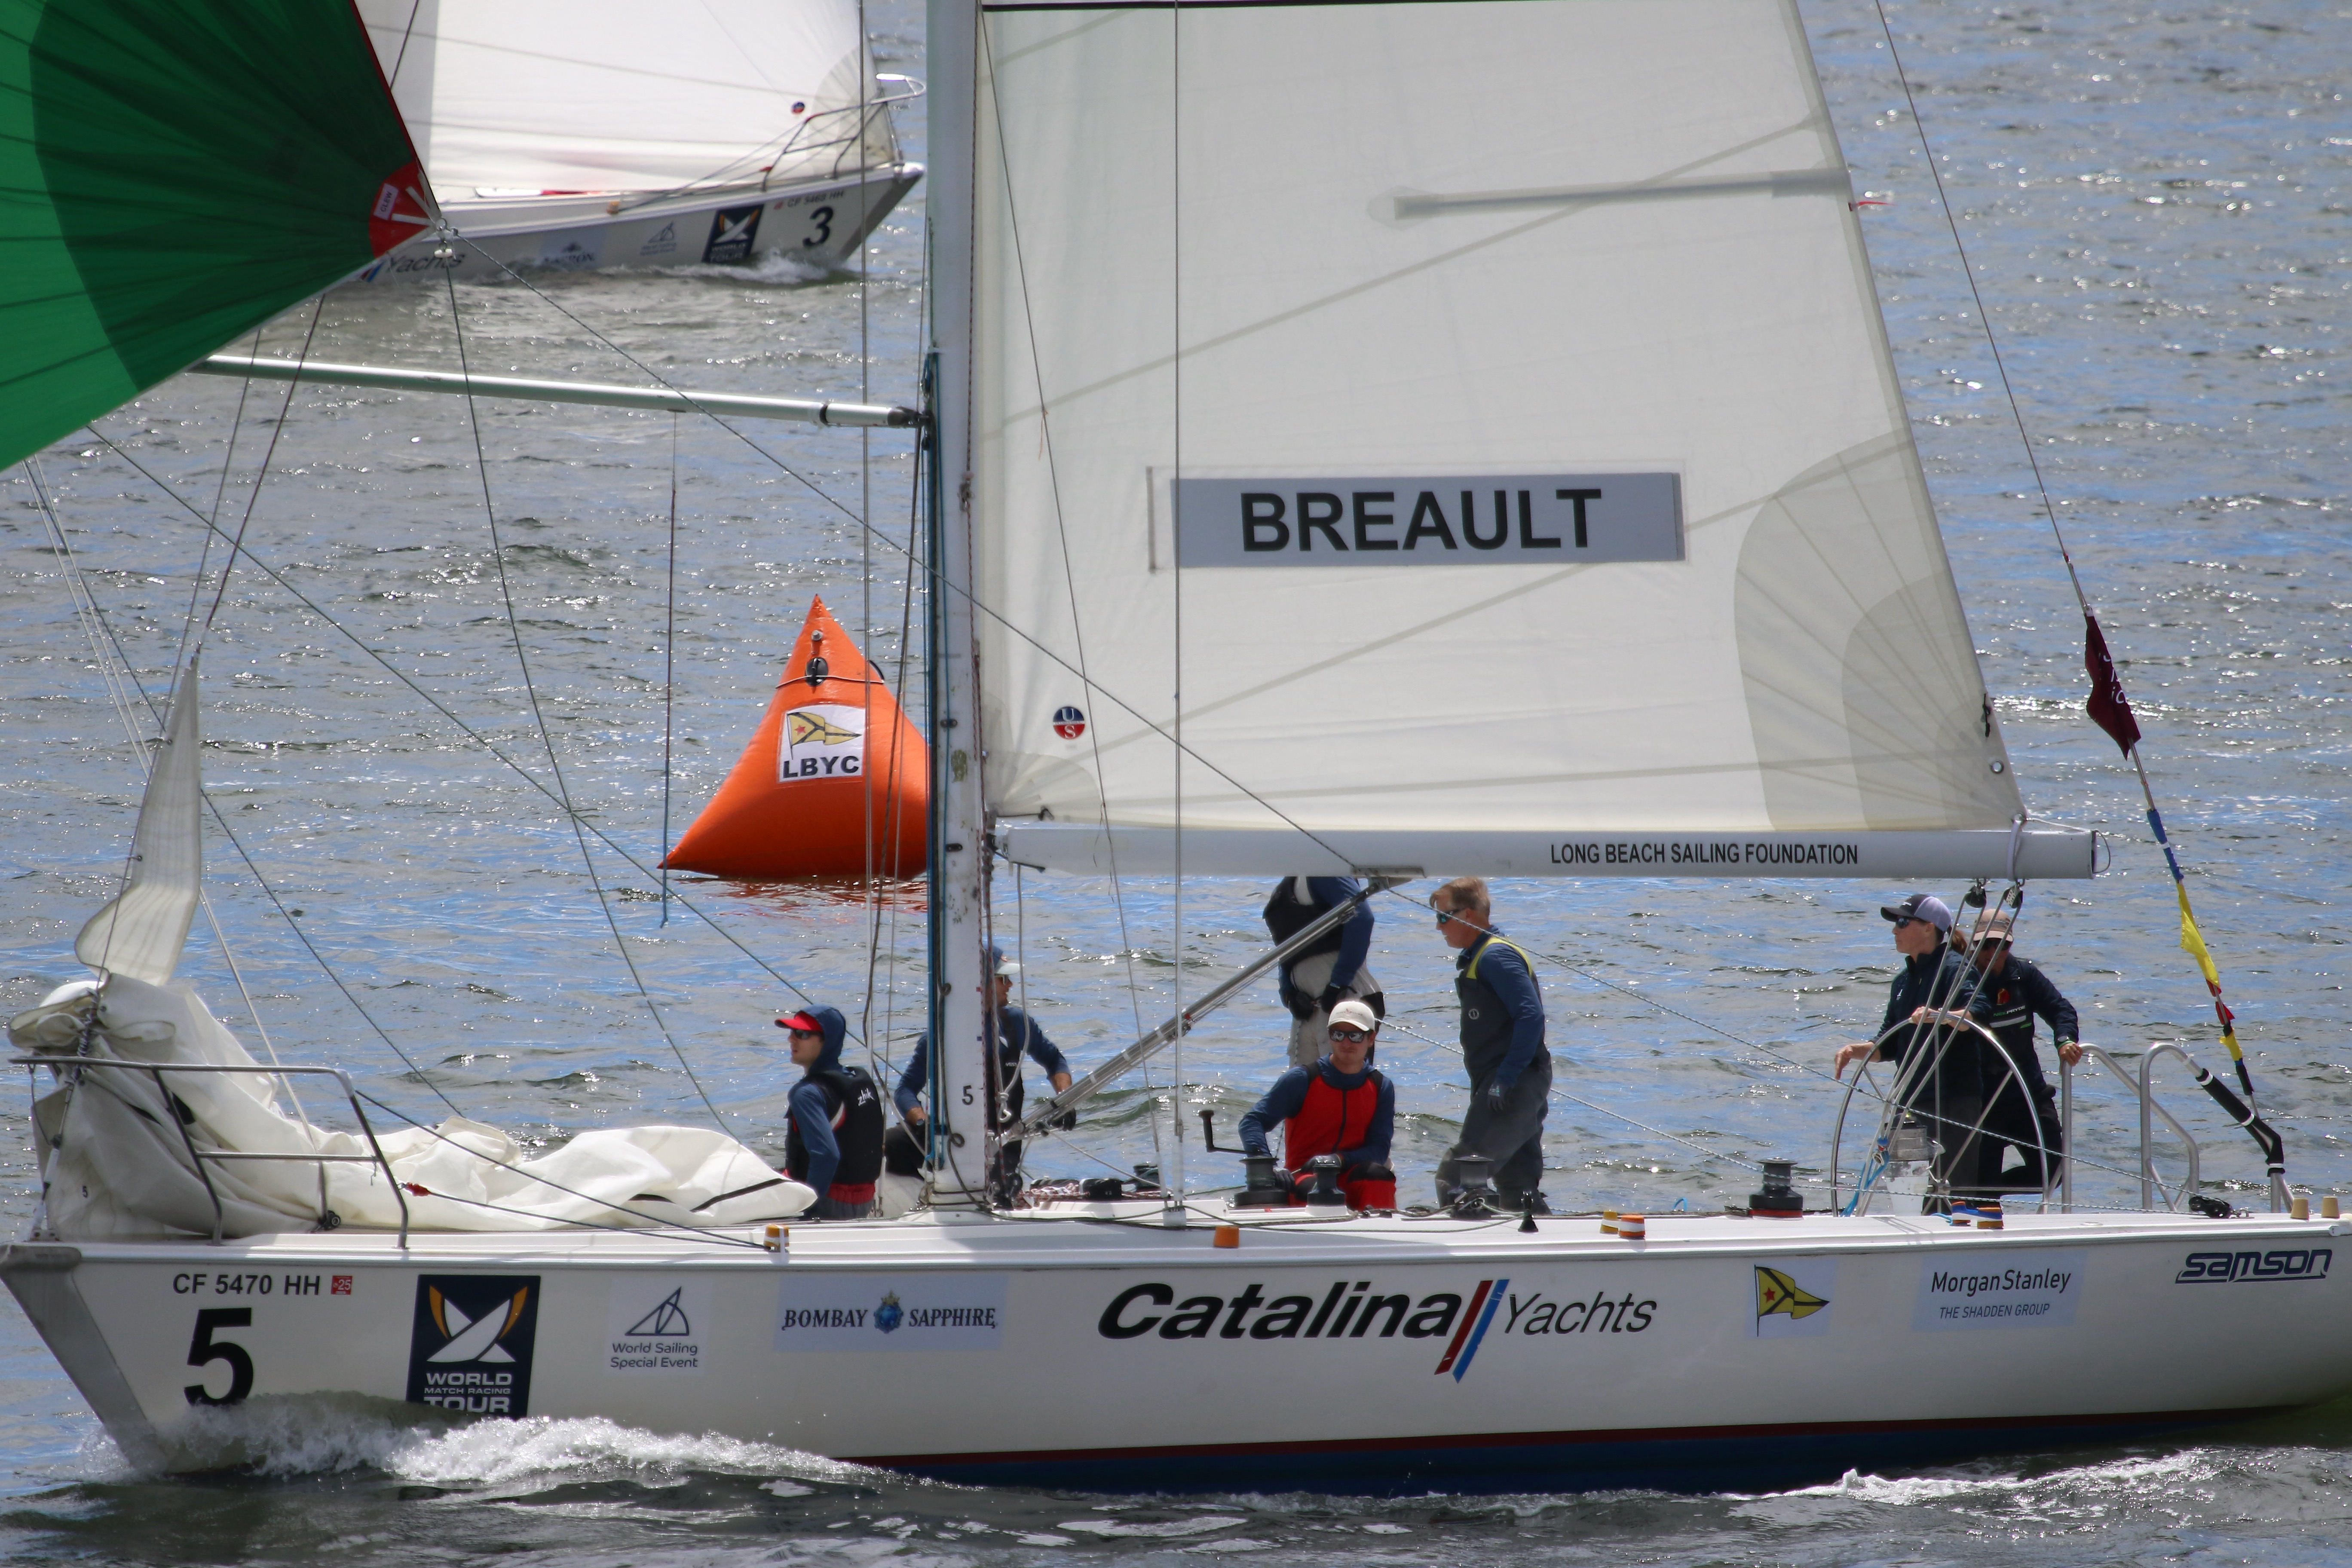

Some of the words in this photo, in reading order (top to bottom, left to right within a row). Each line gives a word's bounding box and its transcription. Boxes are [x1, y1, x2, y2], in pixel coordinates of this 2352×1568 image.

[380, 191, 392, 212] CLEW
[802, 206, 834, 248] 3
[1240, 488, 1602, 552] BREAULT
[783, 755, 859, 779] LBYC
[1550, 843, 1599, 864] LONG
[1605, 843, 1665, 864] BEACH
[1670, 843, 1740, 864] SAILING
[1745, 843, 1858, 864] FOUNDATION
[857, 1087, 875, 1107] zhik
[962, 1084, 974, 1106] 5
[2176, 1249, 2333, 1284] samson
[173, 1273, 207, 1295] CF
[214, 1274, 273, 1295] 5470
[284, 1275, 320, 1295] HH
[338, 1279, 351, 1290] 25
[781, 1309, 868, 1331] BOMBAY
[908, 1308, 996, 1329] SAPPHIRE
[1097, 1281, 1462, 1341] Catalina
[1504, 1291, 1658, 1336] Yachts
[1940, 1306, 1960, 1319] THE
[1962, 1305, 2012, 1318] SHADDEN
[2015, 1303, 2050, 1316] GROUP
[183, 1307, 254, 1406] 5
[612, 1342, 651, 1354] World
[655, 1342, 698, 1356] Sailing
[610, 1357, 657, 1370] Special
[660, 1357, 698, 1368] Event
[426, 1373, 512, 1386] WORLD
[423, 1397, 510, 1413] TOUR
